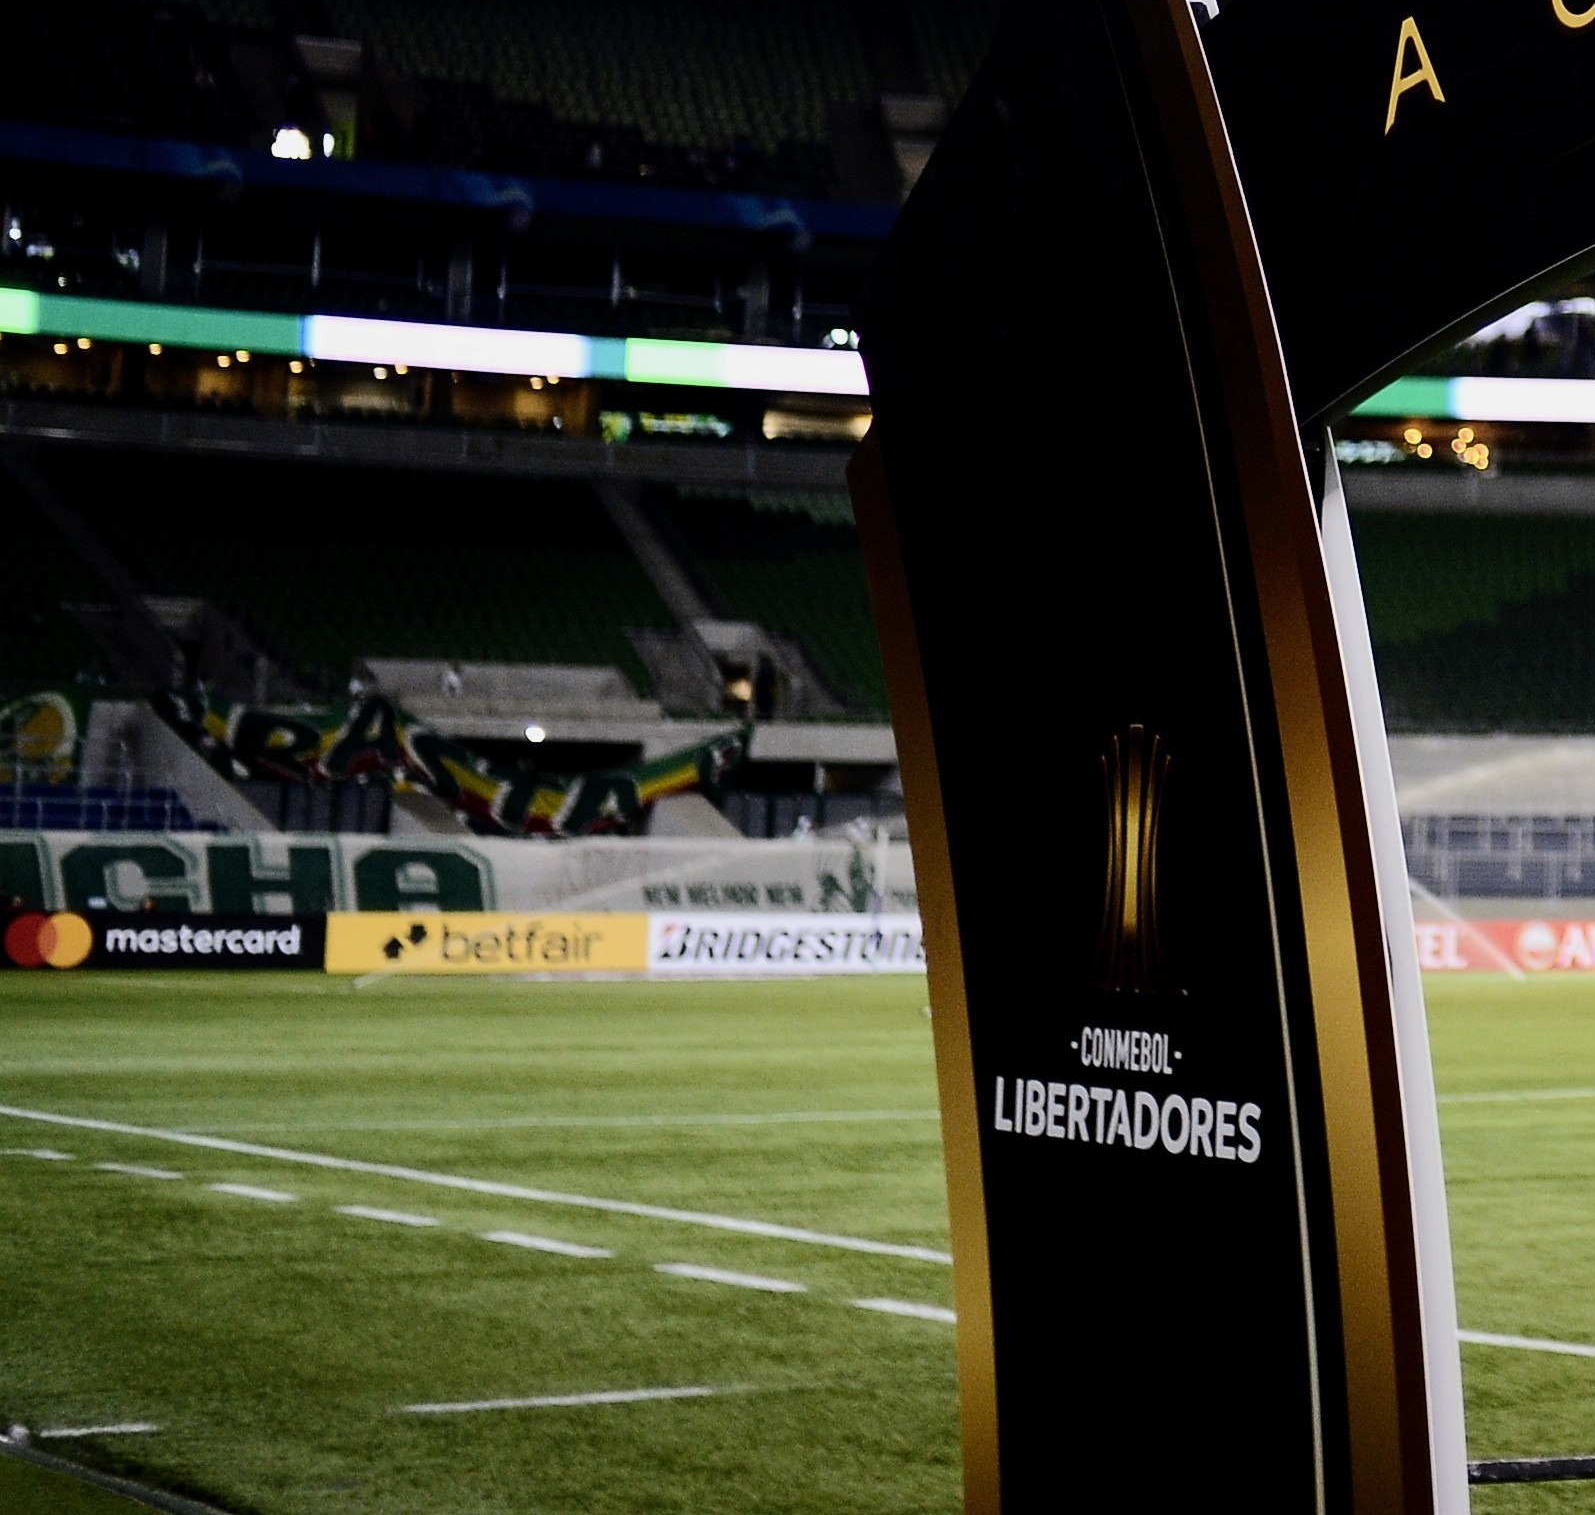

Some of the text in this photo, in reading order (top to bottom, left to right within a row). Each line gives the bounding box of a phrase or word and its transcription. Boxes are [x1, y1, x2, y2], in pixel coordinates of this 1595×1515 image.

[1384, 15, 1446, 136] A
[105, 924, 301, 955] mastercard
[442, 920, 603, 963] betfair
[994, 1075, 1262, 1164] LIBERTADORES
